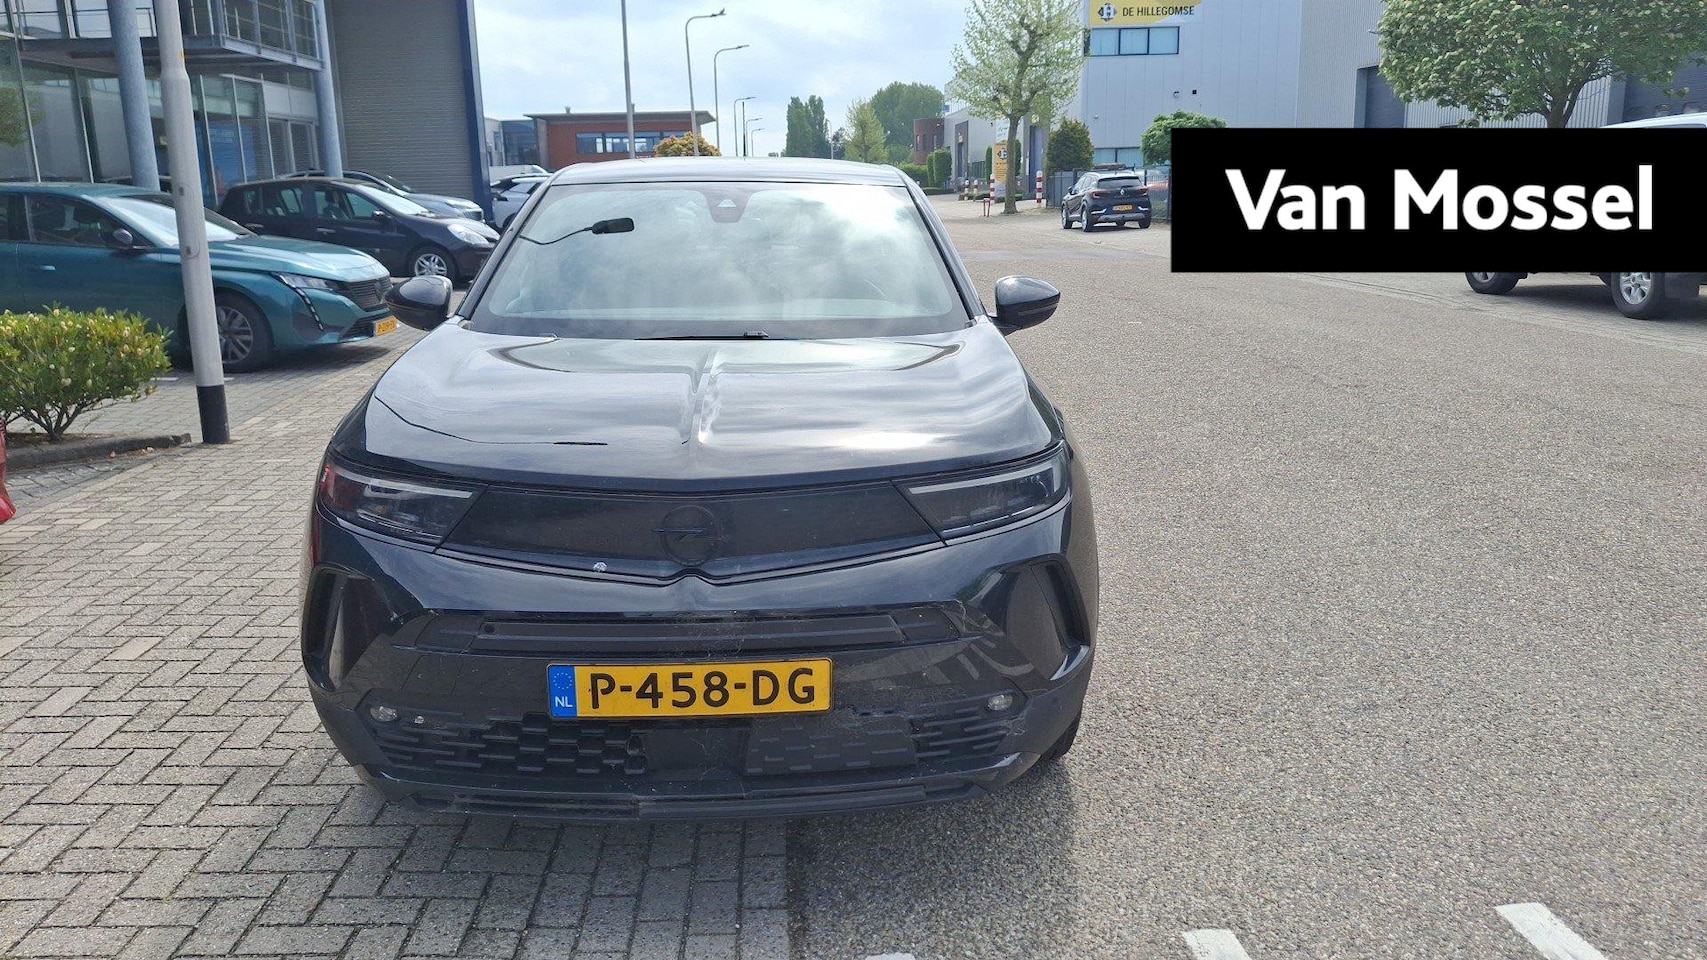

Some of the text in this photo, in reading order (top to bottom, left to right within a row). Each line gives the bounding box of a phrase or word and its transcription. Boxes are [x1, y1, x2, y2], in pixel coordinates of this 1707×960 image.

[1122, 6, 1195, 16] DE HILLEGOMSE
[589, 668, 816, 709] P-458-DG
[555, 696, 573, 708] NL
